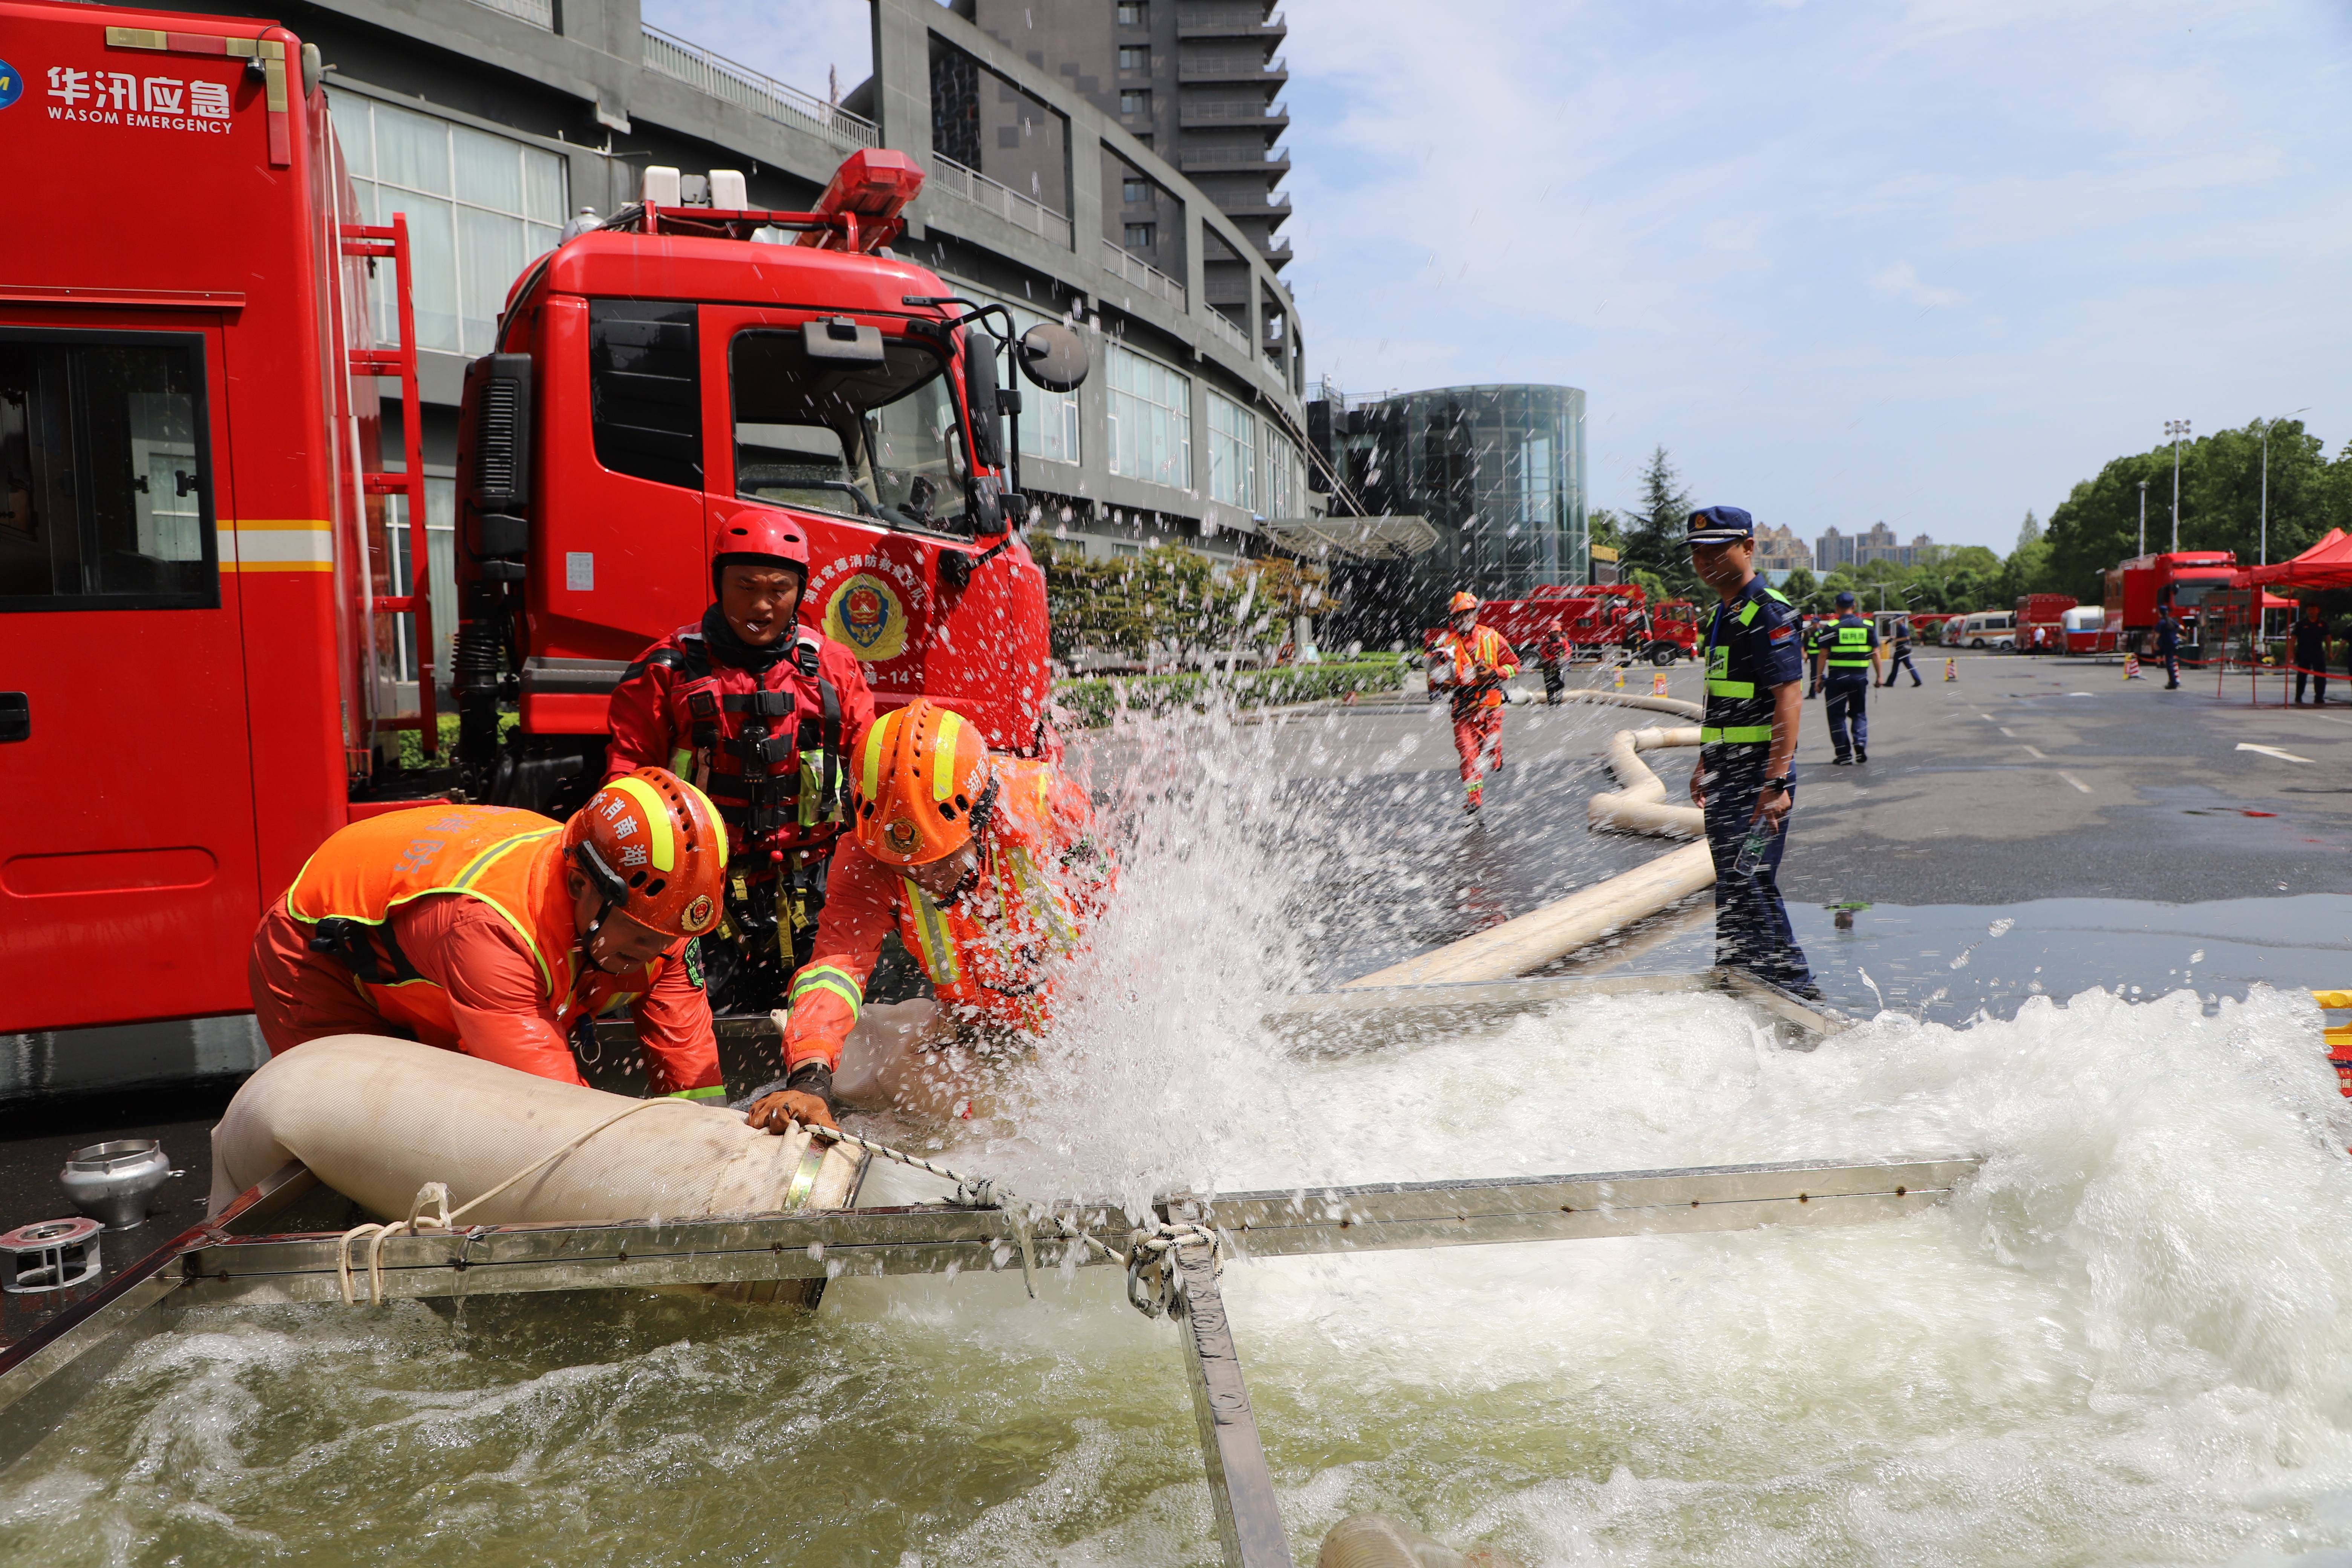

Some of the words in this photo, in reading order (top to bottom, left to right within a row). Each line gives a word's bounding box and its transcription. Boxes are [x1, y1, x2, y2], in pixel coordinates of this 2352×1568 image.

[47, 66, 230, 119] 华汛应急
[47, 106, 119, 124] WASOM
[127, 113, 232, 134] EMERGENCY
[803, 554, 925, 604] 湖南常德消防救援支队
